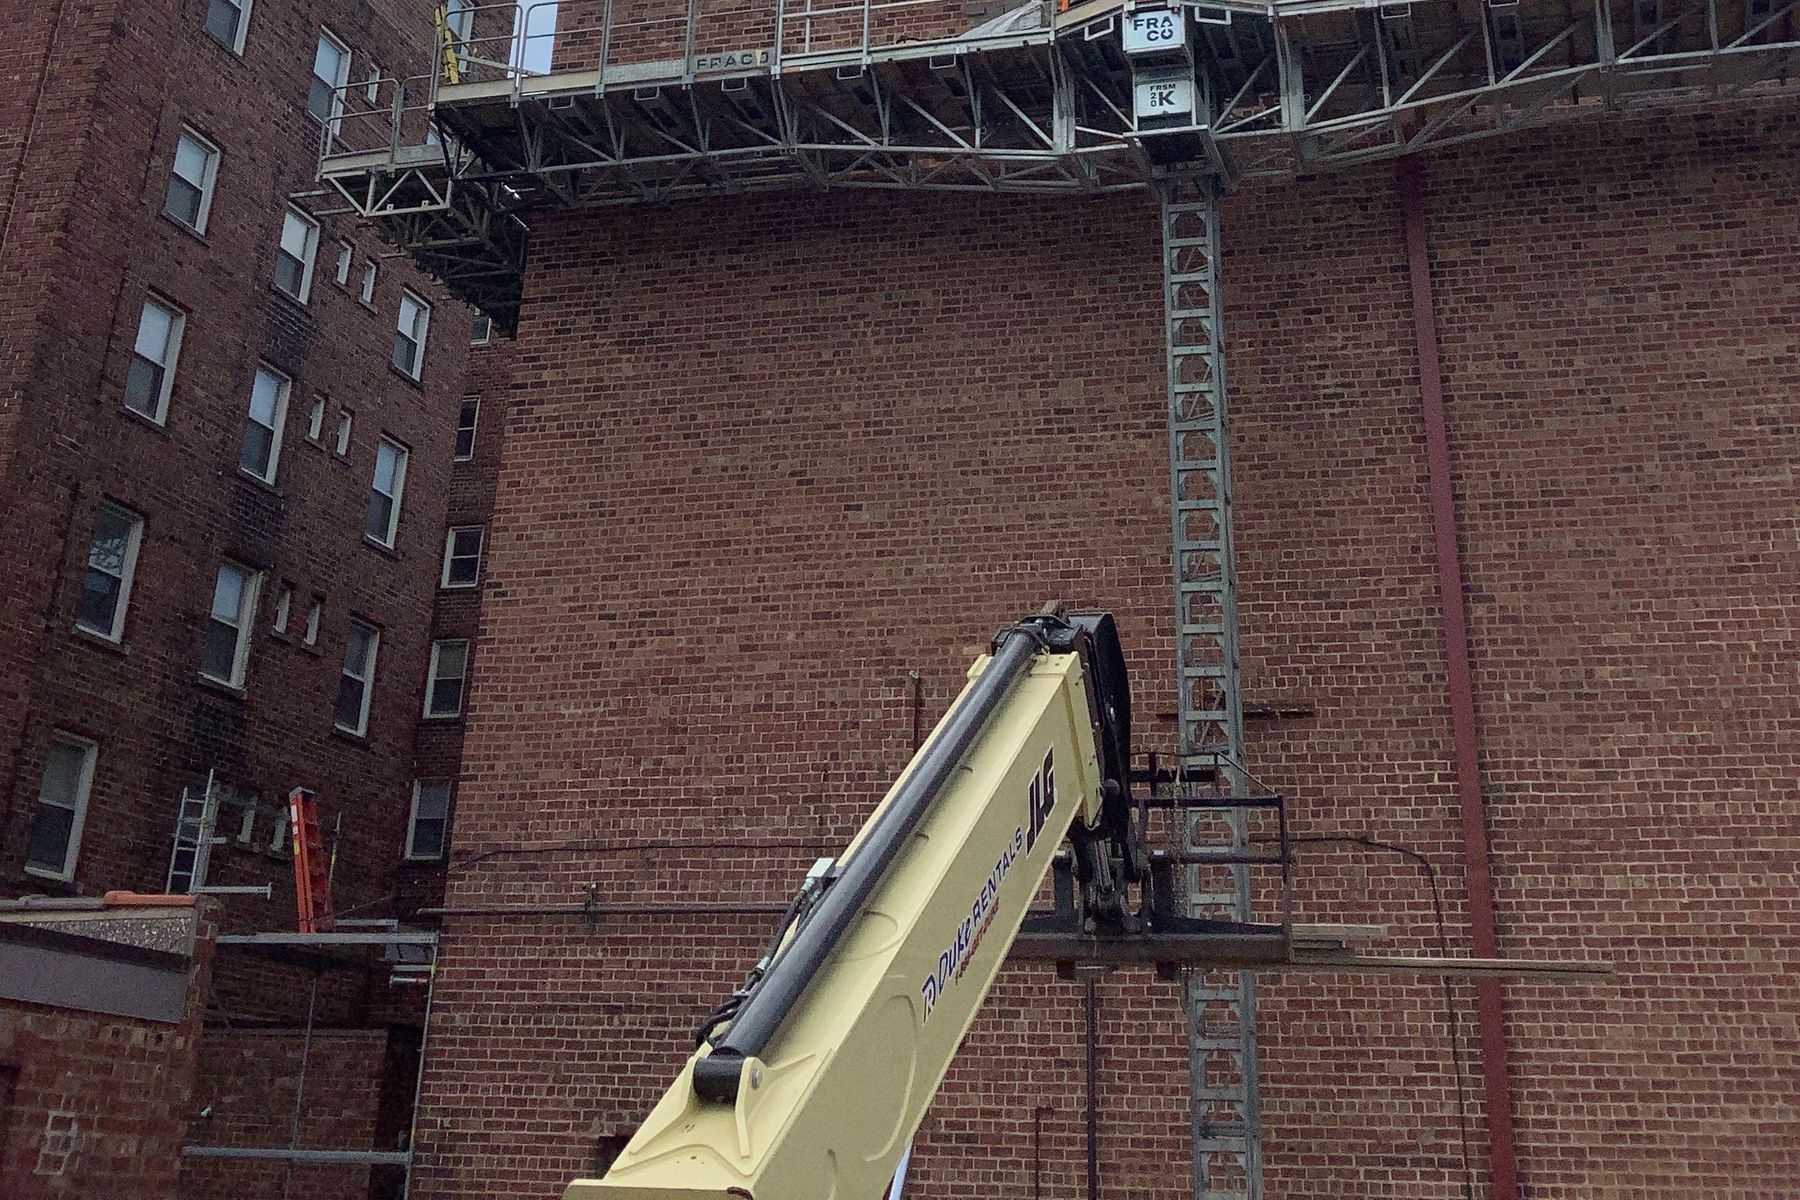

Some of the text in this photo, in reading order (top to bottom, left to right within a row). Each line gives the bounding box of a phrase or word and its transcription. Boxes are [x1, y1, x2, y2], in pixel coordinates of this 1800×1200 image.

[1133, 16, 1174, 31] FRA
[1146, 28, 1174, 42] CO
[1149, 83, 1177, 92] FRSM
[1026, 745, 1056, 856] JLG
[972, 826, 1024, 928] RENTALS
